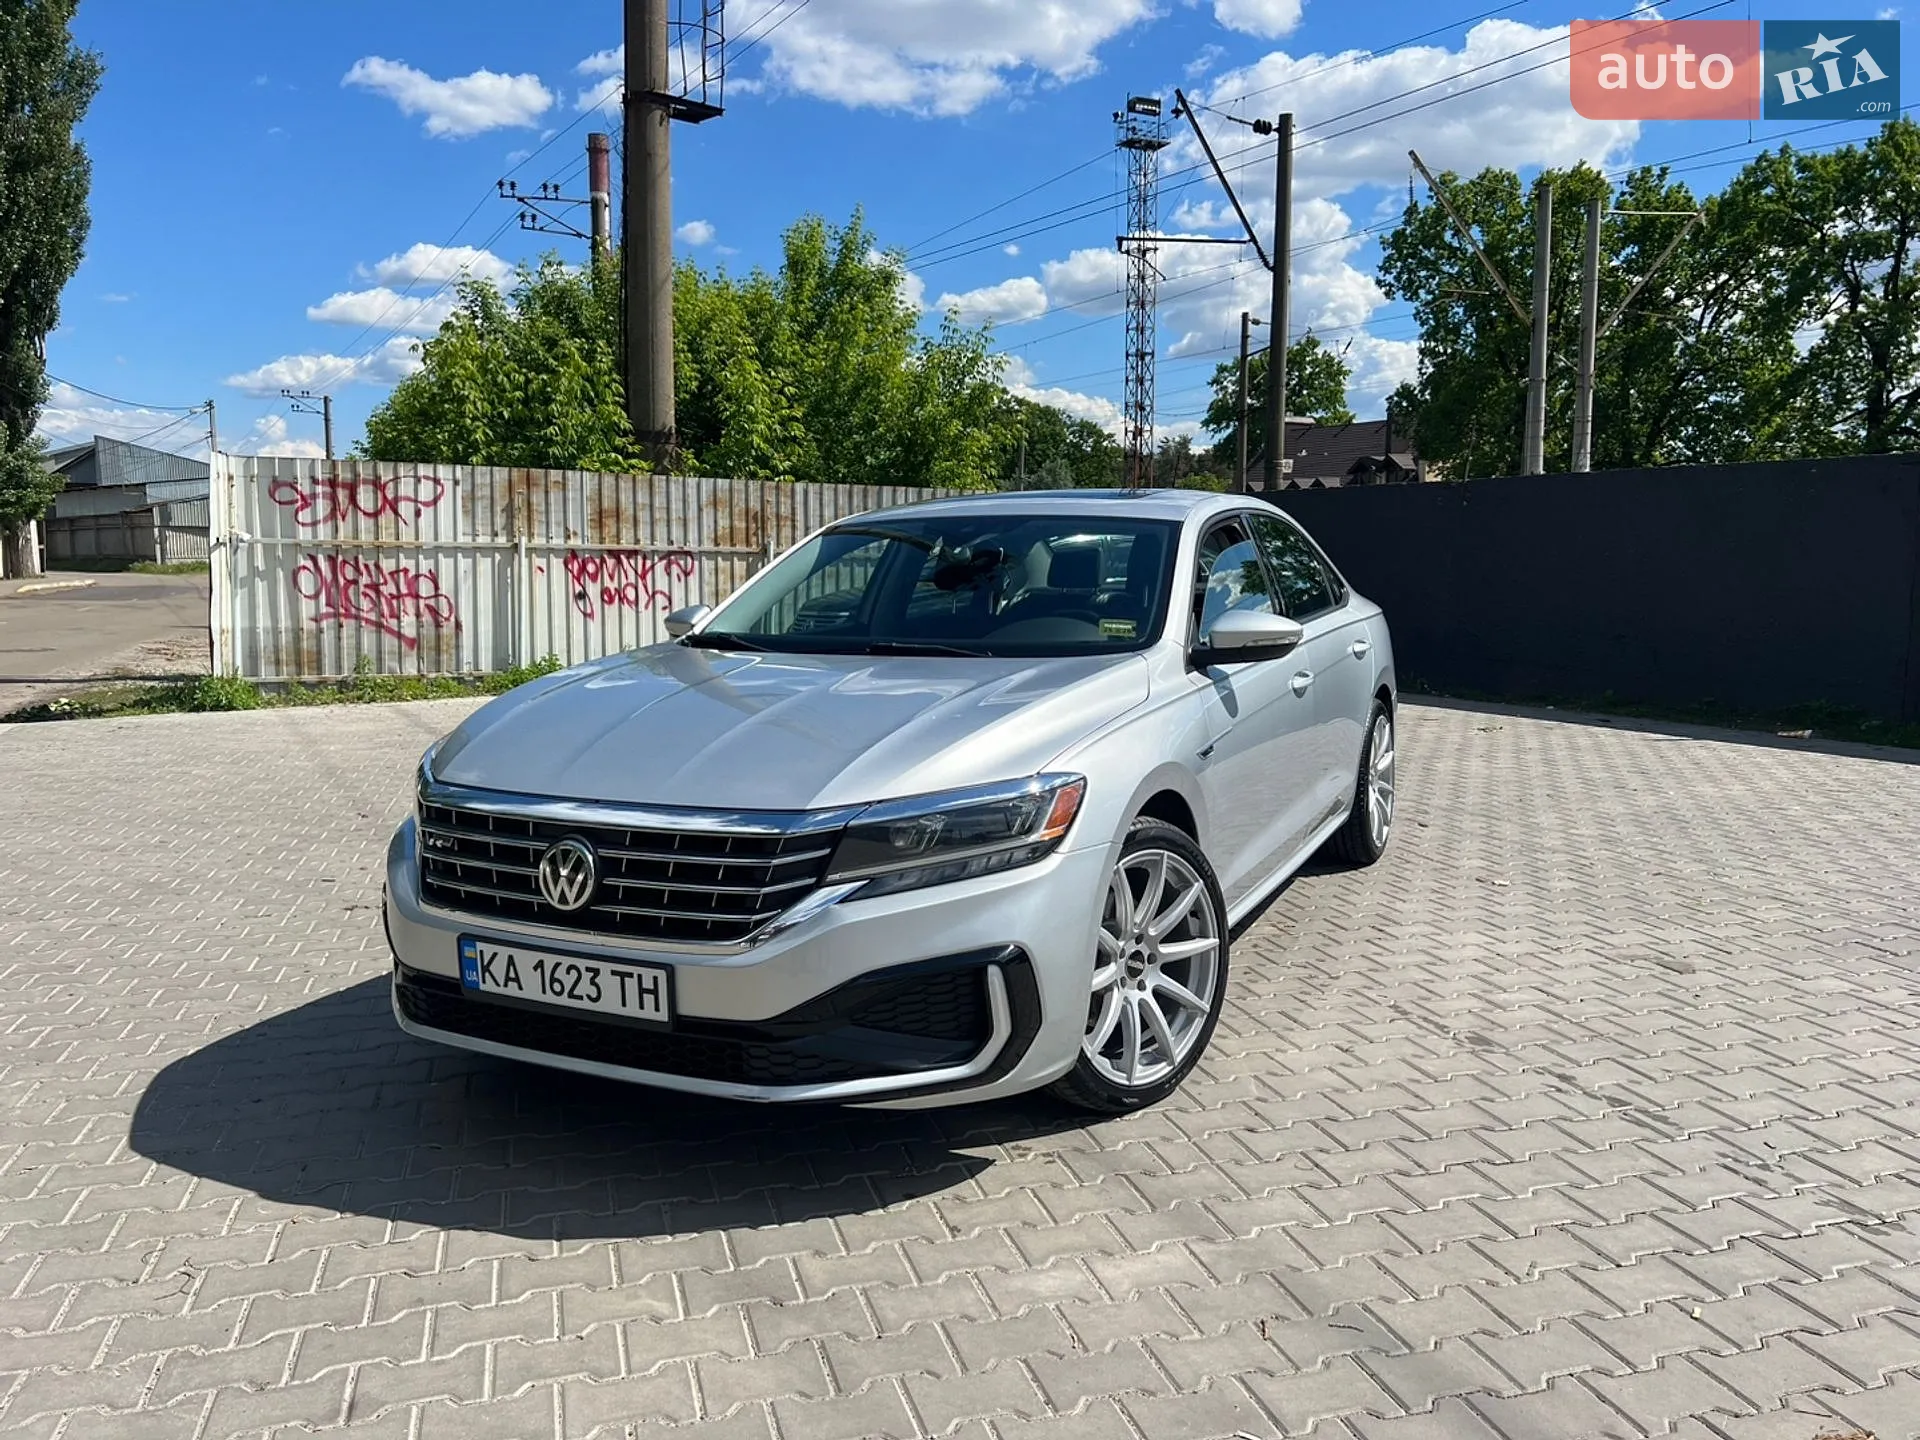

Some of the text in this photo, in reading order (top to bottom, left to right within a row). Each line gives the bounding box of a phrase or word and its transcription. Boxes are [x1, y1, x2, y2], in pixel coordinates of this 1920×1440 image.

[479, 949, 661, 1013] KA 1623 TH
